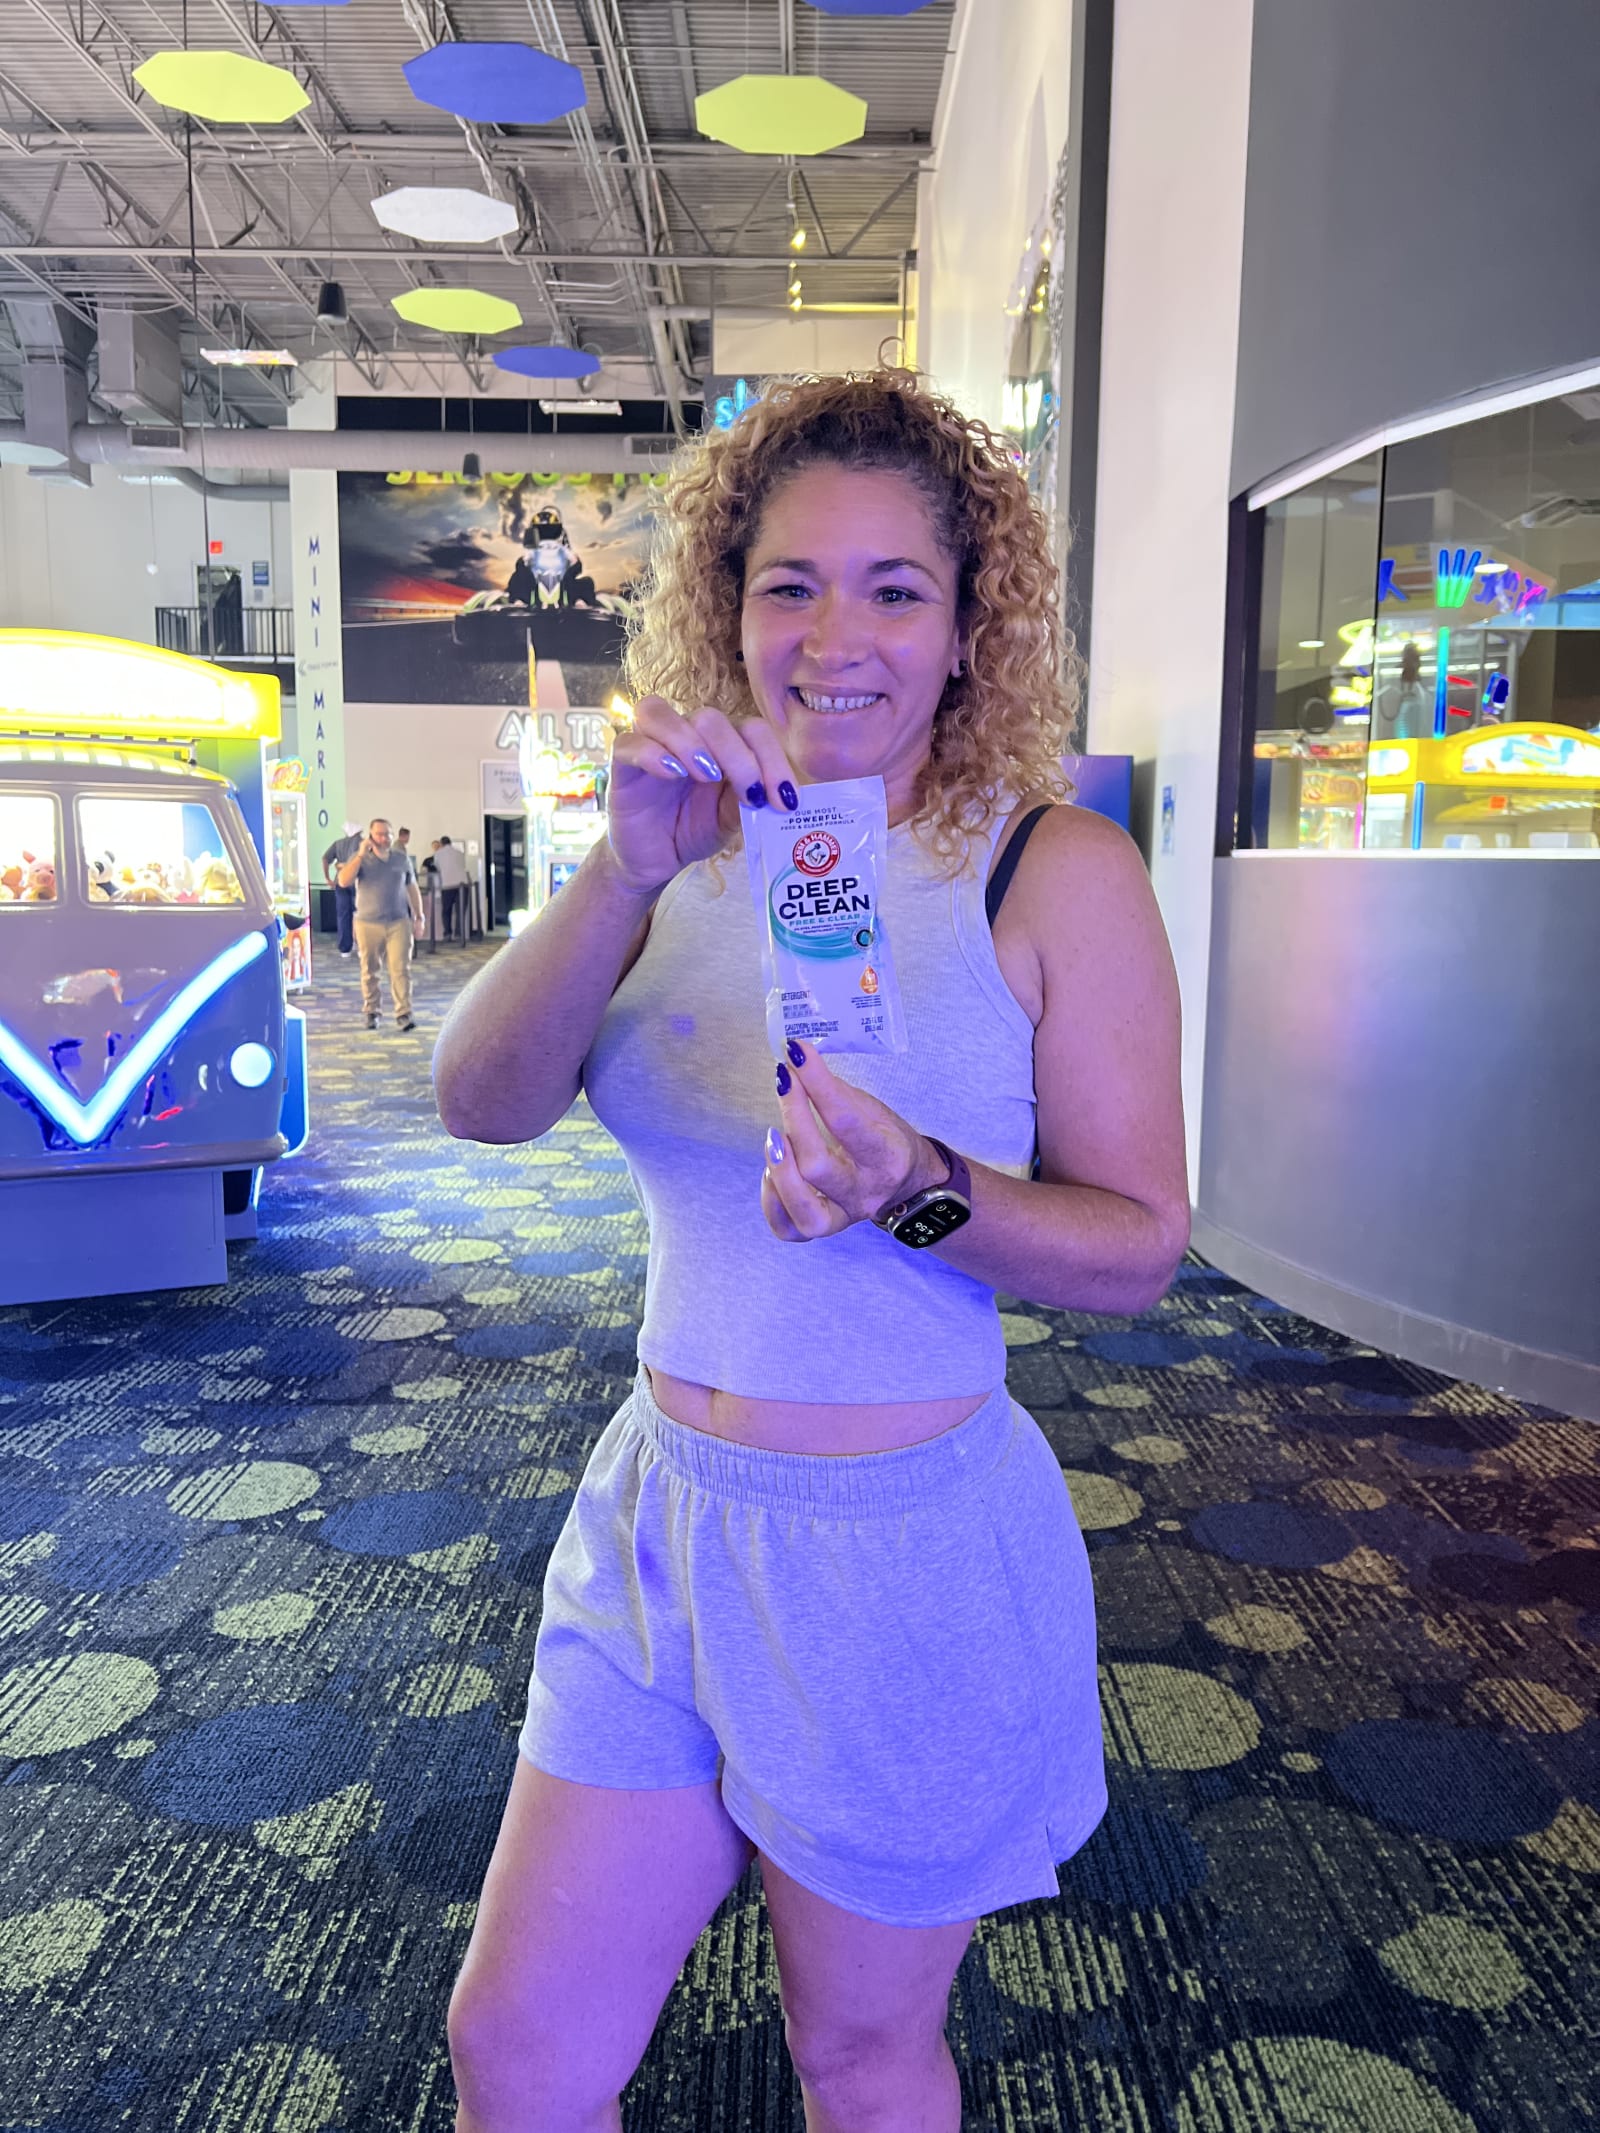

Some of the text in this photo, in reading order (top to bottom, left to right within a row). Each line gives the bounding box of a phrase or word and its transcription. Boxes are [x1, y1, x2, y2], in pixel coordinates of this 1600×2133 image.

[789, 814, 843, 824] POWERFUL
[794, 809, 812, 817] OUR
[787, 877, 858, 901] DEEP
[779, 894, 870, 920] CLEAN
[789, 917, 815, 927] FREE
[827, 913, 860, 922] CLEAR
